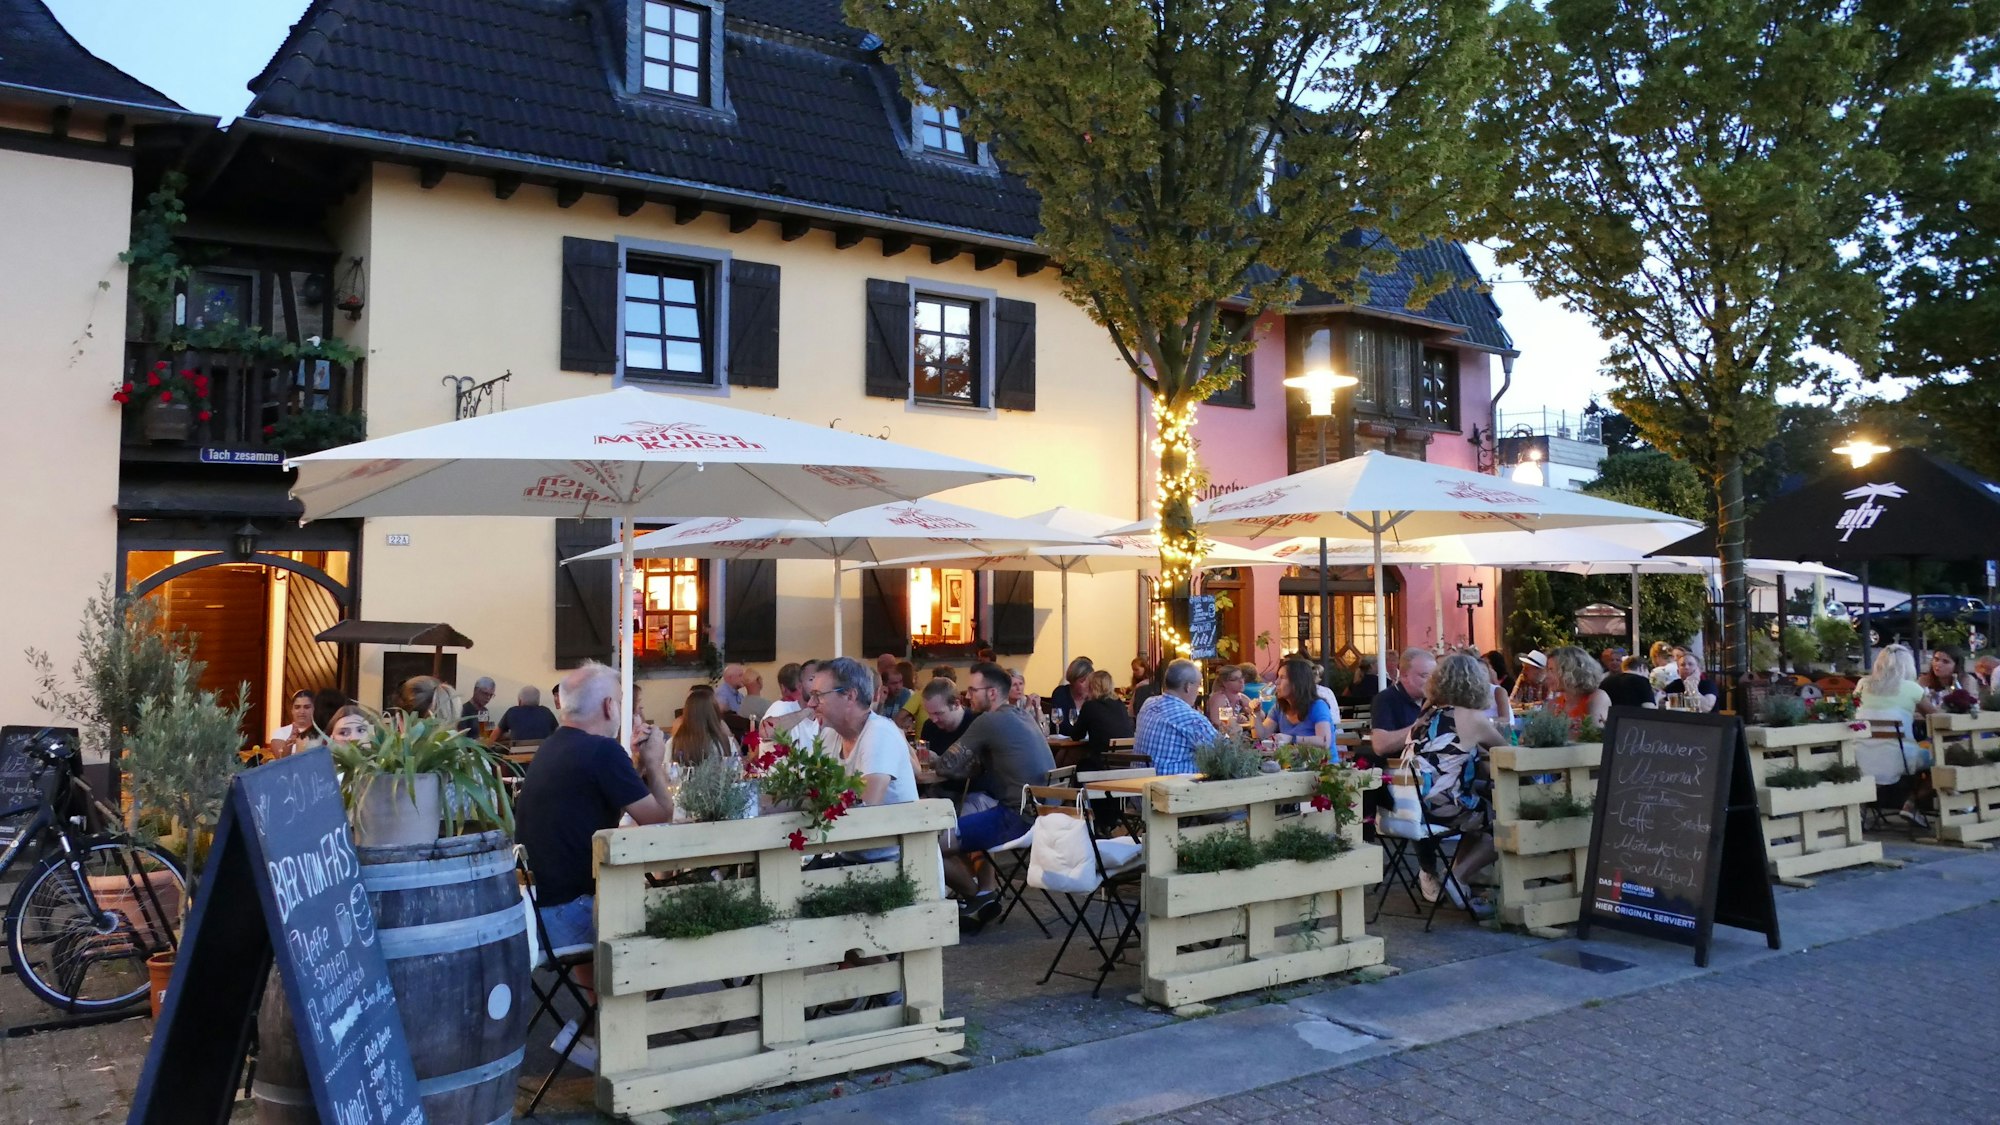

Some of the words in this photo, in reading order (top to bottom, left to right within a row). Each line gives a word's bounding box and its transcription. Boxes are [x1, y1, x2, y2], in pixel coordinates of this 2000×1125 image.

[594, 432, 743, 445] Mühlen
[642, 440, 766, 450] Kölsch
[208, 448, 230, 461] Tach
[234, 451, 279, 462] zesamme
[1838, 502, 1884, 526] afri
[267, 855, 304, 925] BIER
[297, 850, 326, 898] VOM
[320, 822, 360, 888] FASS
[1621, 882, 1655, 895] ORIGINAL
[1595, 901, 1614, 912] HIER
[1614, 905, 1652, 920] ORIGINAL
[1653, 913, 1696, 929] SERVIERT!
